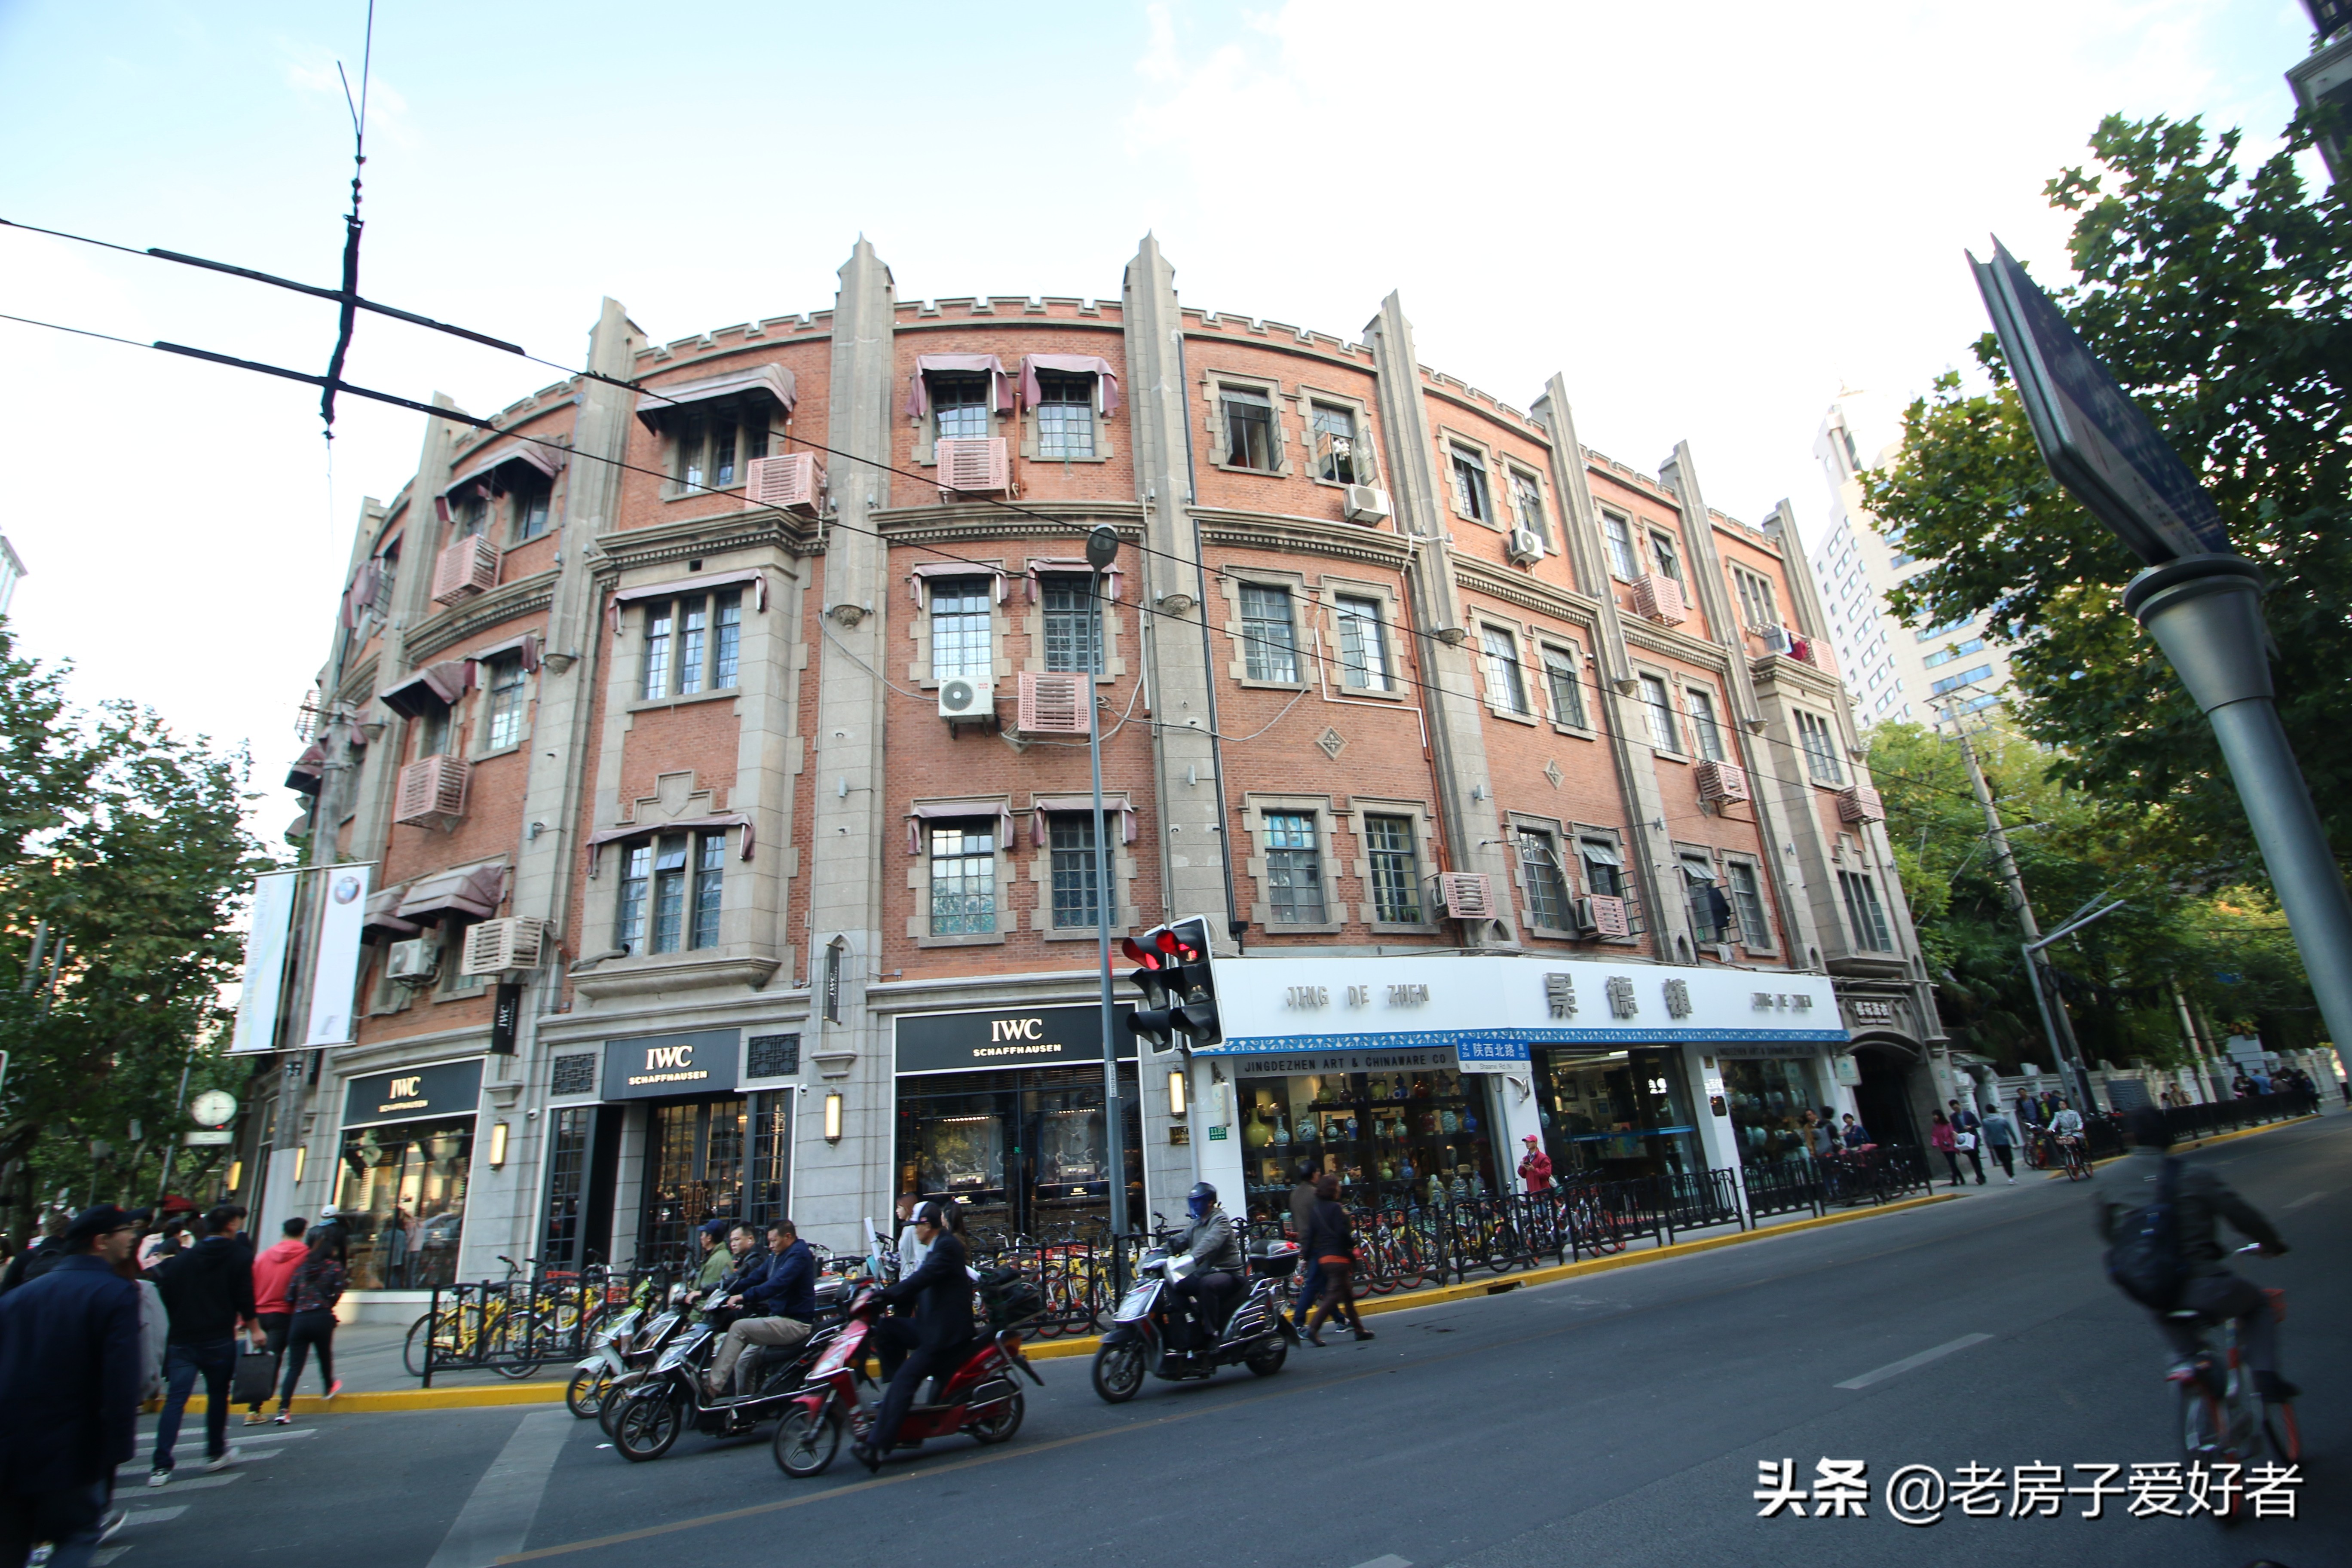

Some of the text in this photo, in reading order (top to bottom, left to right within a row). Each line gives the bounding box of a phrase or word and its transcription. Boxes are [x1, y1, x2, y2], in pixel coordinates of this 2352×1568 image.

[1286, 984, 1430, 1006] JING DE ZHEN
[991, 1018, 1043, 1042] IWC
[645, 1045, 693, 1070] IWC
[973, 1044, 1062, 1057] SCHAFFHAUSEN
[1473, 1043, 1515, 1057] 陕西北路
[1245, 1060, 1316, 1072] JINGDEZHEN
[1323, 1058, 1344, 1069] ART
[1352, 1057, 1359, 1067] &
[1366, 1055, 1426, 1067] CHINAWARE
[628, 1070, 708, 1085] SCHAFFHAUSEN
[389, 1076, 421, 1099] IWC
